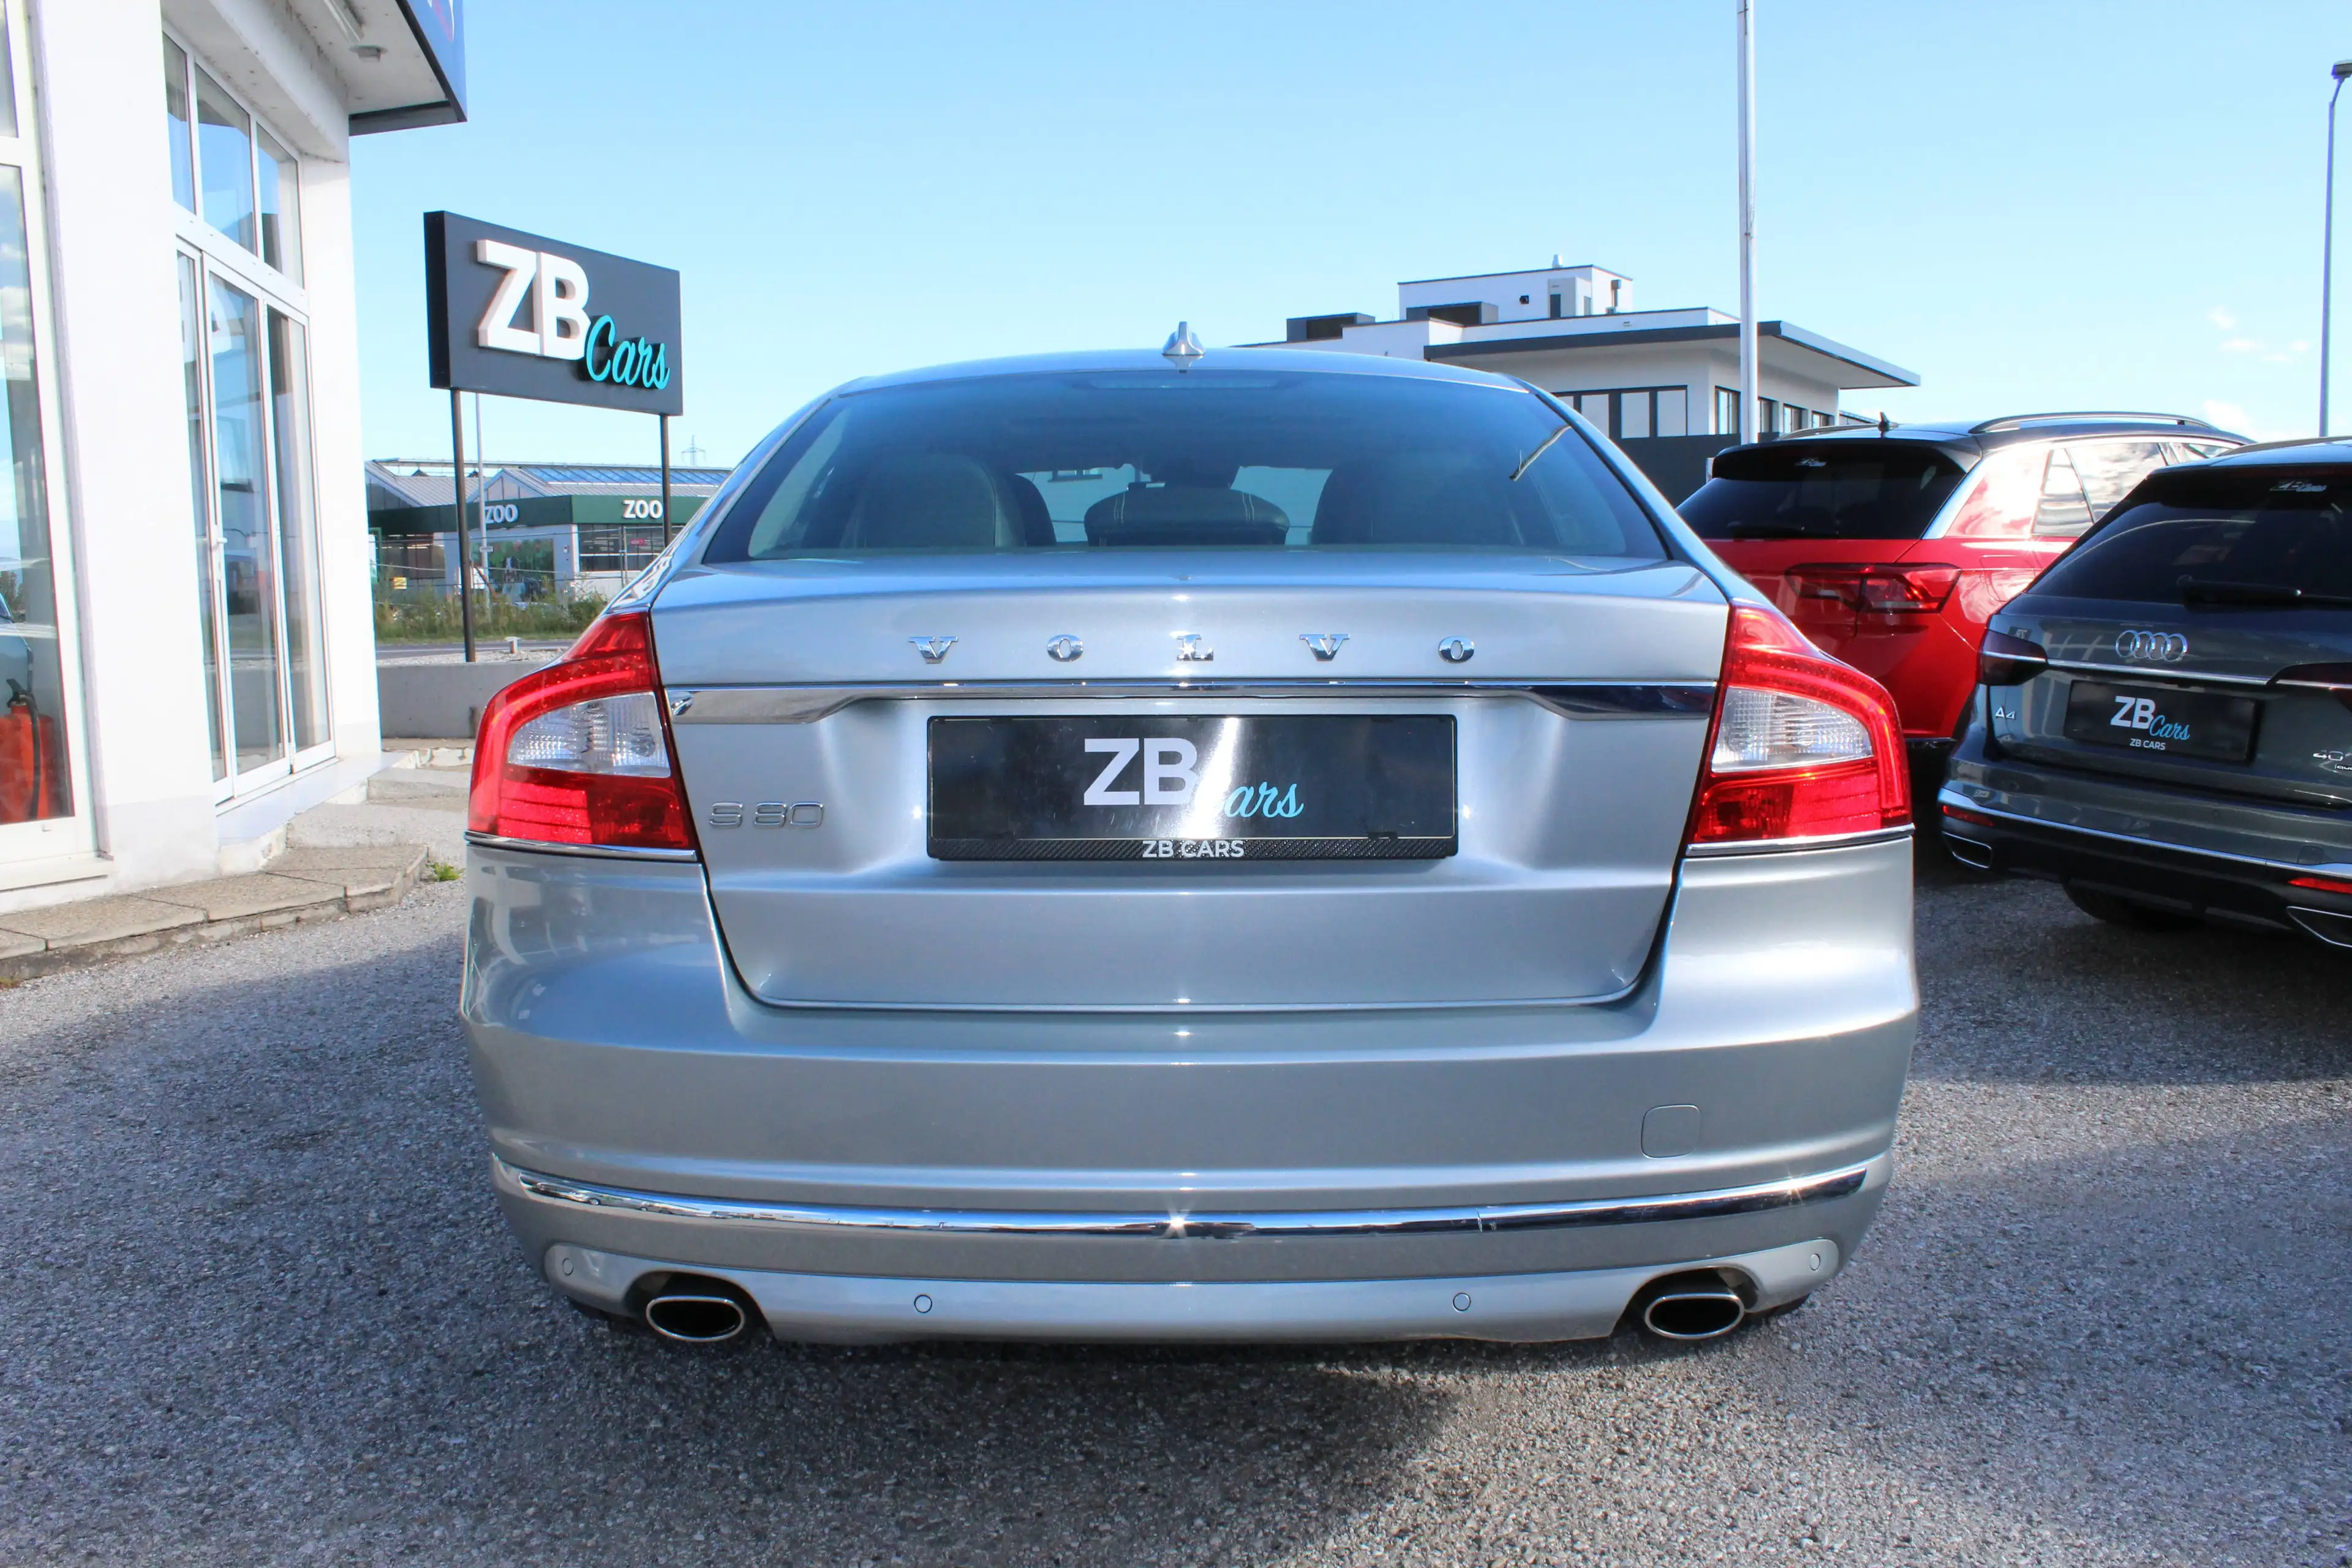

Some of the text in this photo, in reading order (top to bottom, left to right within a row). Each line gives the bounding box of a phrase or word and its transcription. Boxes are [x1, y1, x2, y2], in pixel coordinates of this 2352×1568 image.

[477, 239, 670, 390] ZB Cars
[623, 500, 663, 519] ZOO
[908, 634, 1475, 663] VOLVO
[1994, 706, 2016, 719] A4
[2110, 696, 2190, 740] ZB Cars
[2130, 738, 2166, 750] ZB CARS
[1084, 737, 1304, 818] ZB ars
[708, 801, 824, 828] S80
[1142, 840, 1245, 858] ZB CARS
